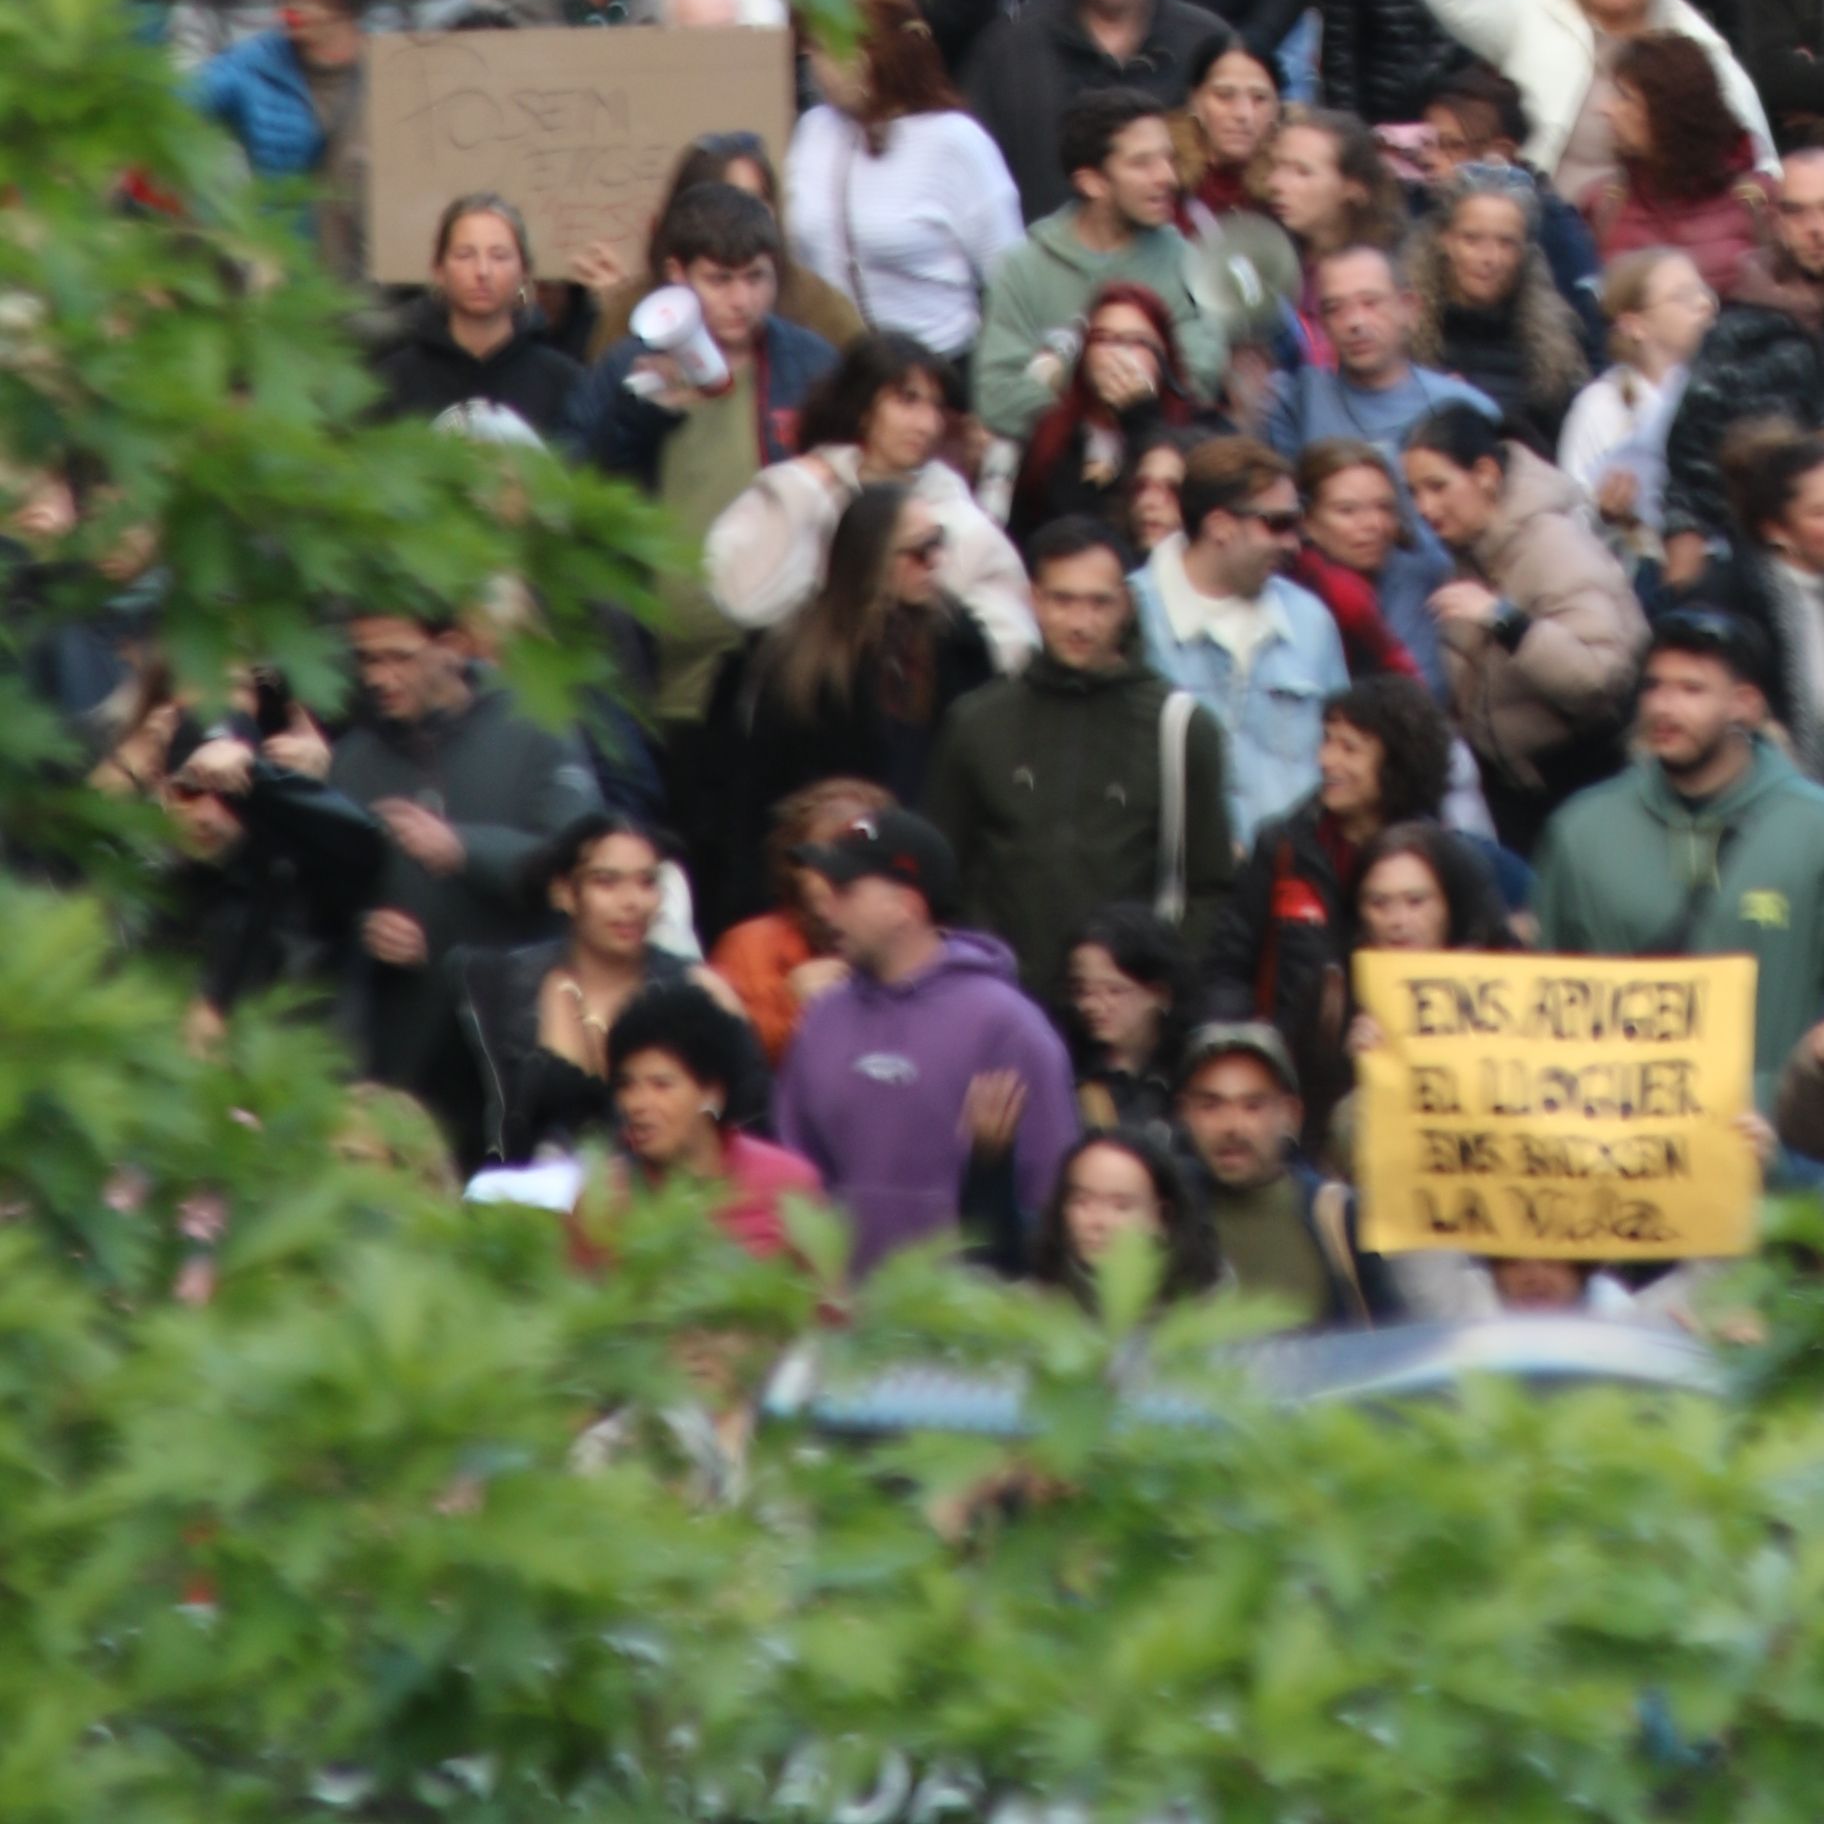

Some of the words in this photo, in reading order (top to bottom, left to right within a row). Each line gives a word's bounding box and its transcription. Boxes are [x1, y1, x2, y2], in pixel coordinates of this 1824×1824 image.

[1405, 975, 1513, 1036] ENS
[1408, 1064, 1463, 1116] EL
[1478, 1056, 1705, 1121] LLOGUER
[1416, 1128, 1507, 1176] ENS
[1411, 1189, 1496, 1238] LA
